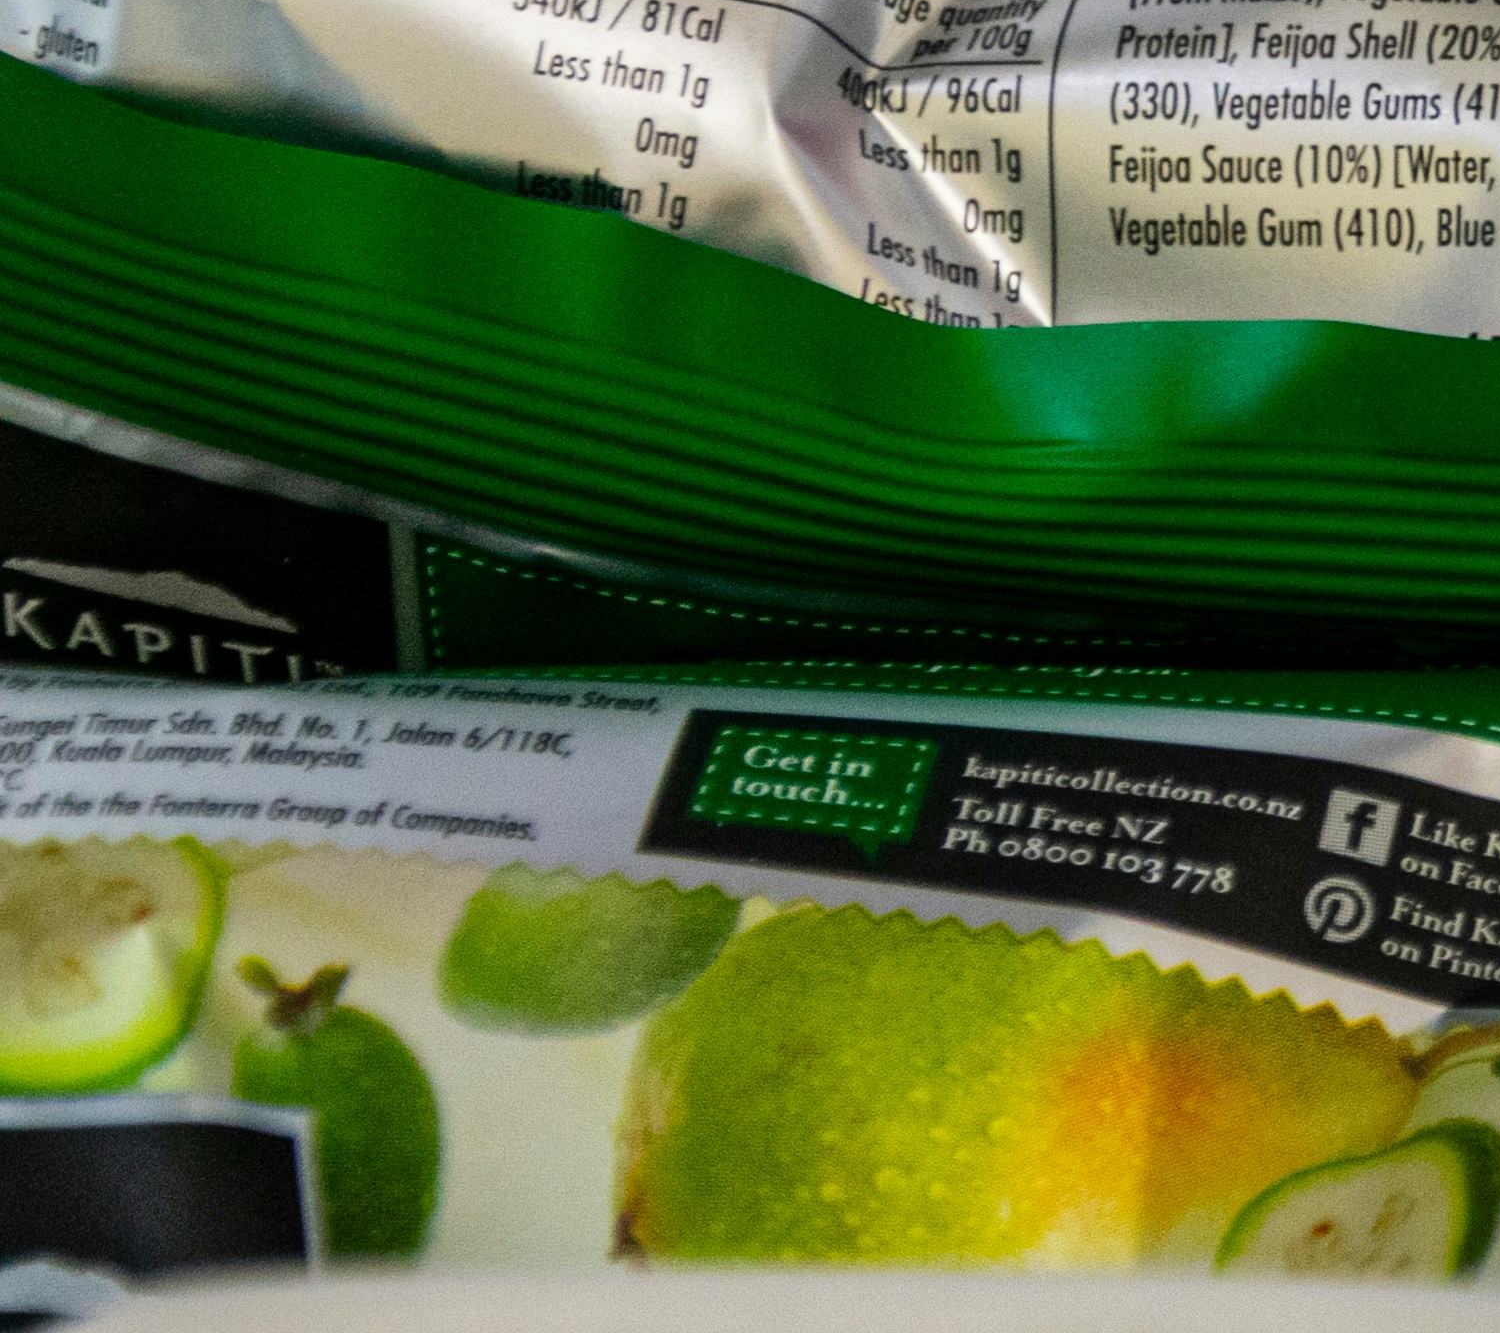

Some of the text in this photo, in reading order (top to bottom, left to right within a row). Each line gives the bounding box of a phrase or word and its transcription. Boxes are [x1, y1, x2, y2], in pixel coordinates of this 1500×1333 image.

[641, 0, 725, 44] 81Cal
[533, 40, 710, 109] Less than 1g
[1108, 80, 1200, 127] (330),
[1211, 79, 1351, 131] Vegetable
[1362, 82, 1442, 123] Gums
[636, 117, 698, 168] 0mg
[1109, 144, 1192, 192] Feijoa
[1201, 146, 1283, 185] Sauce
[1294, 143, 1383, 189] (10%)
[1394, 143, 1496, 191] [Water,
[1108, 207, 1247, 256] Vegetable
[1257, 209, 1323, 247] Gum
[1334, 208, 1425, 254] (410),
[1437, 207, 1495, 247] Blue
[2, 591, 304, 687] KAPITI
[51, 738, 124, 763] Kuala
[743, 743, 875, 780] Get in
[731, 774, 886, 811] touch...
[962, 754, 1304, 822] kapiticollection.co.nz
[951, 794, 1174, 845] Toll Free NZ
[1409, 811, 1477, 854] Like
[941, 828, 1238, 896] Ph 0800 103 778
[1400, 851, 1439, 875] on
[1388, 895, 1465, 939] Find
[1379, 935, 1422, 959] on
